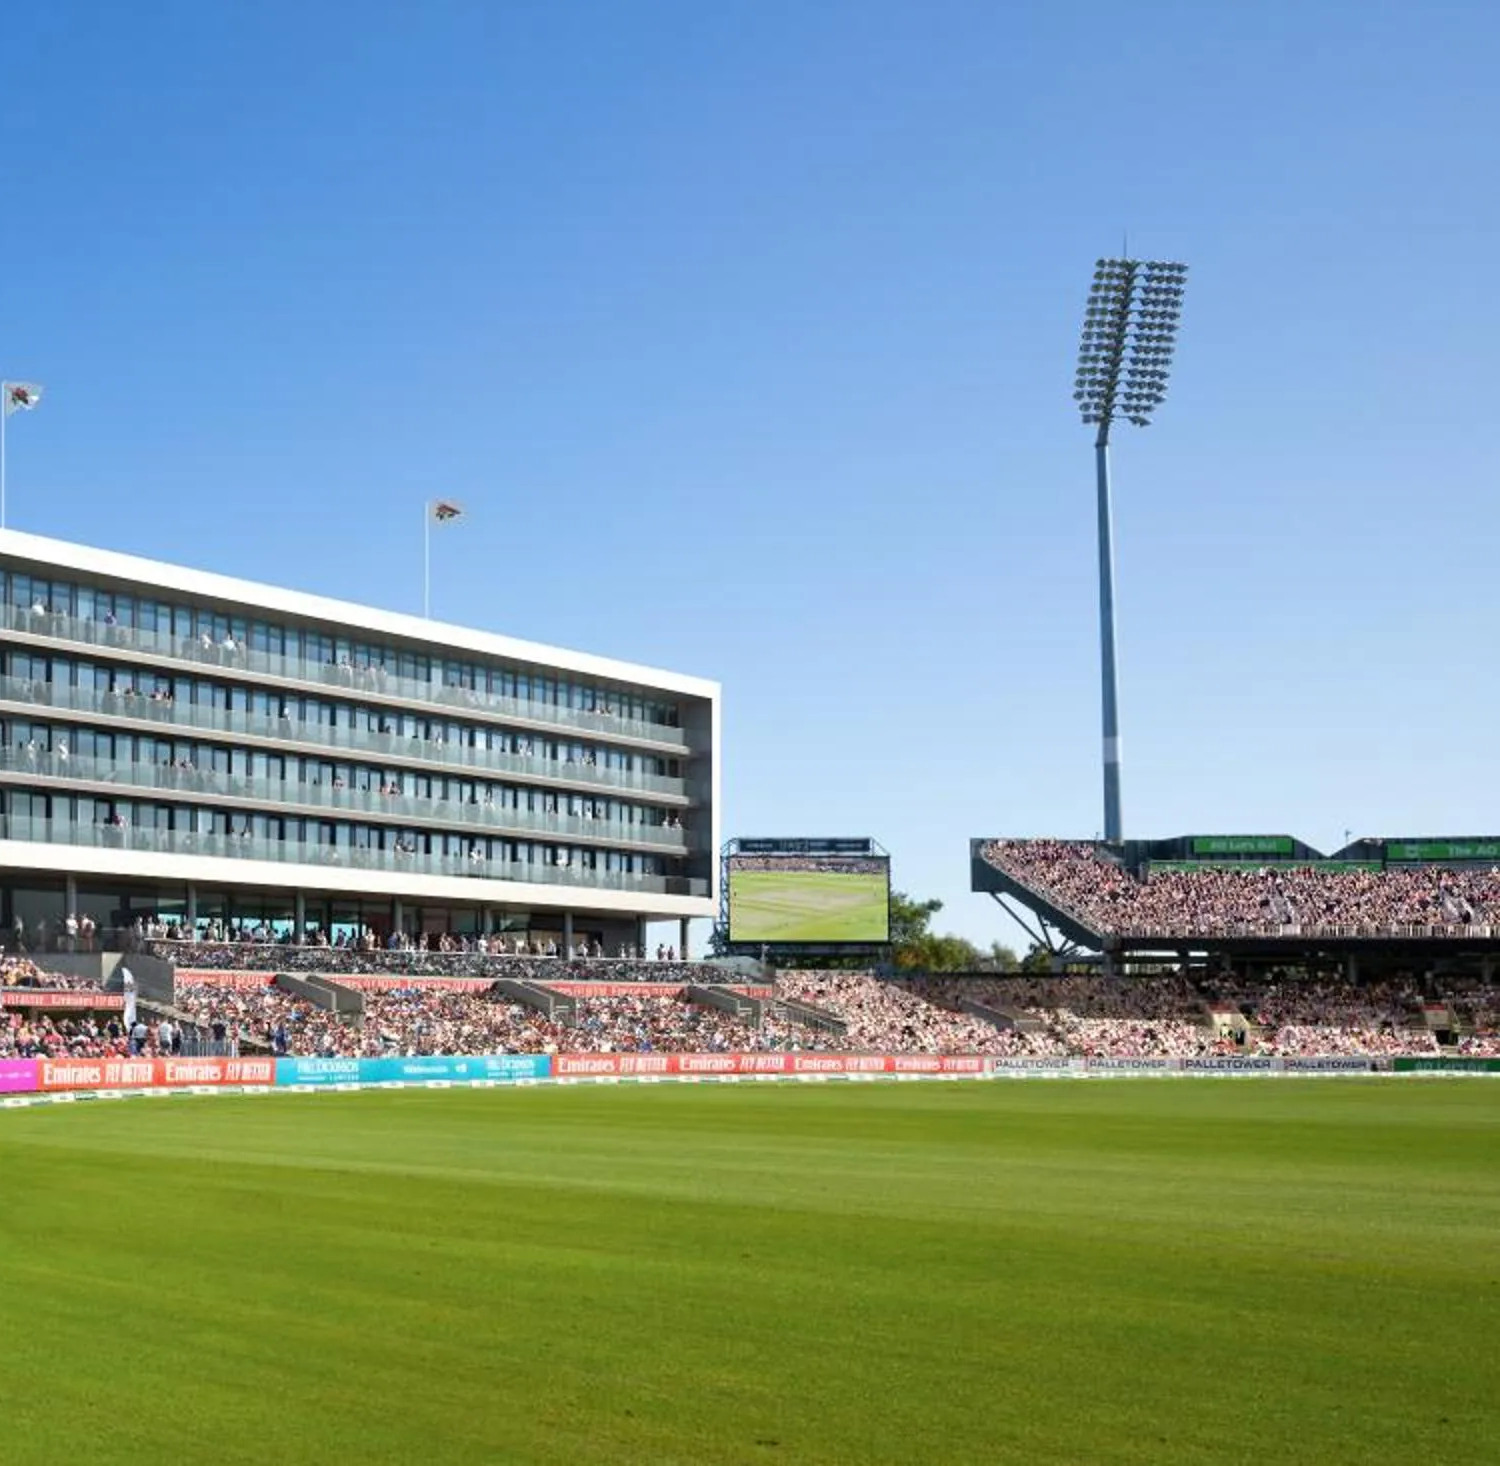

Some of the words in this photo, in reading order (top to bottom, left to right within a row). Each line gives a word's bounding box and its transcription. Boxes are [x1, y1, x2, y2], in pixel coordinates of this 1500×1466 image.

[558, 1057, 615, 1073] Emirates
[678, 1056, 736, 1072] Emirates
[995, 1058, 1069, 1068] PALLETOWER
[1089, 1058, 1166, 1068] PALLETOWER
[1186, 1059, 1271, 1069] PALLETOWER
[1290, 1060, 1367, 1069] PALLETOWER
[44, 1062, 100, 1085] Emirates
[165, 1061, 222, 1083] Emirates
